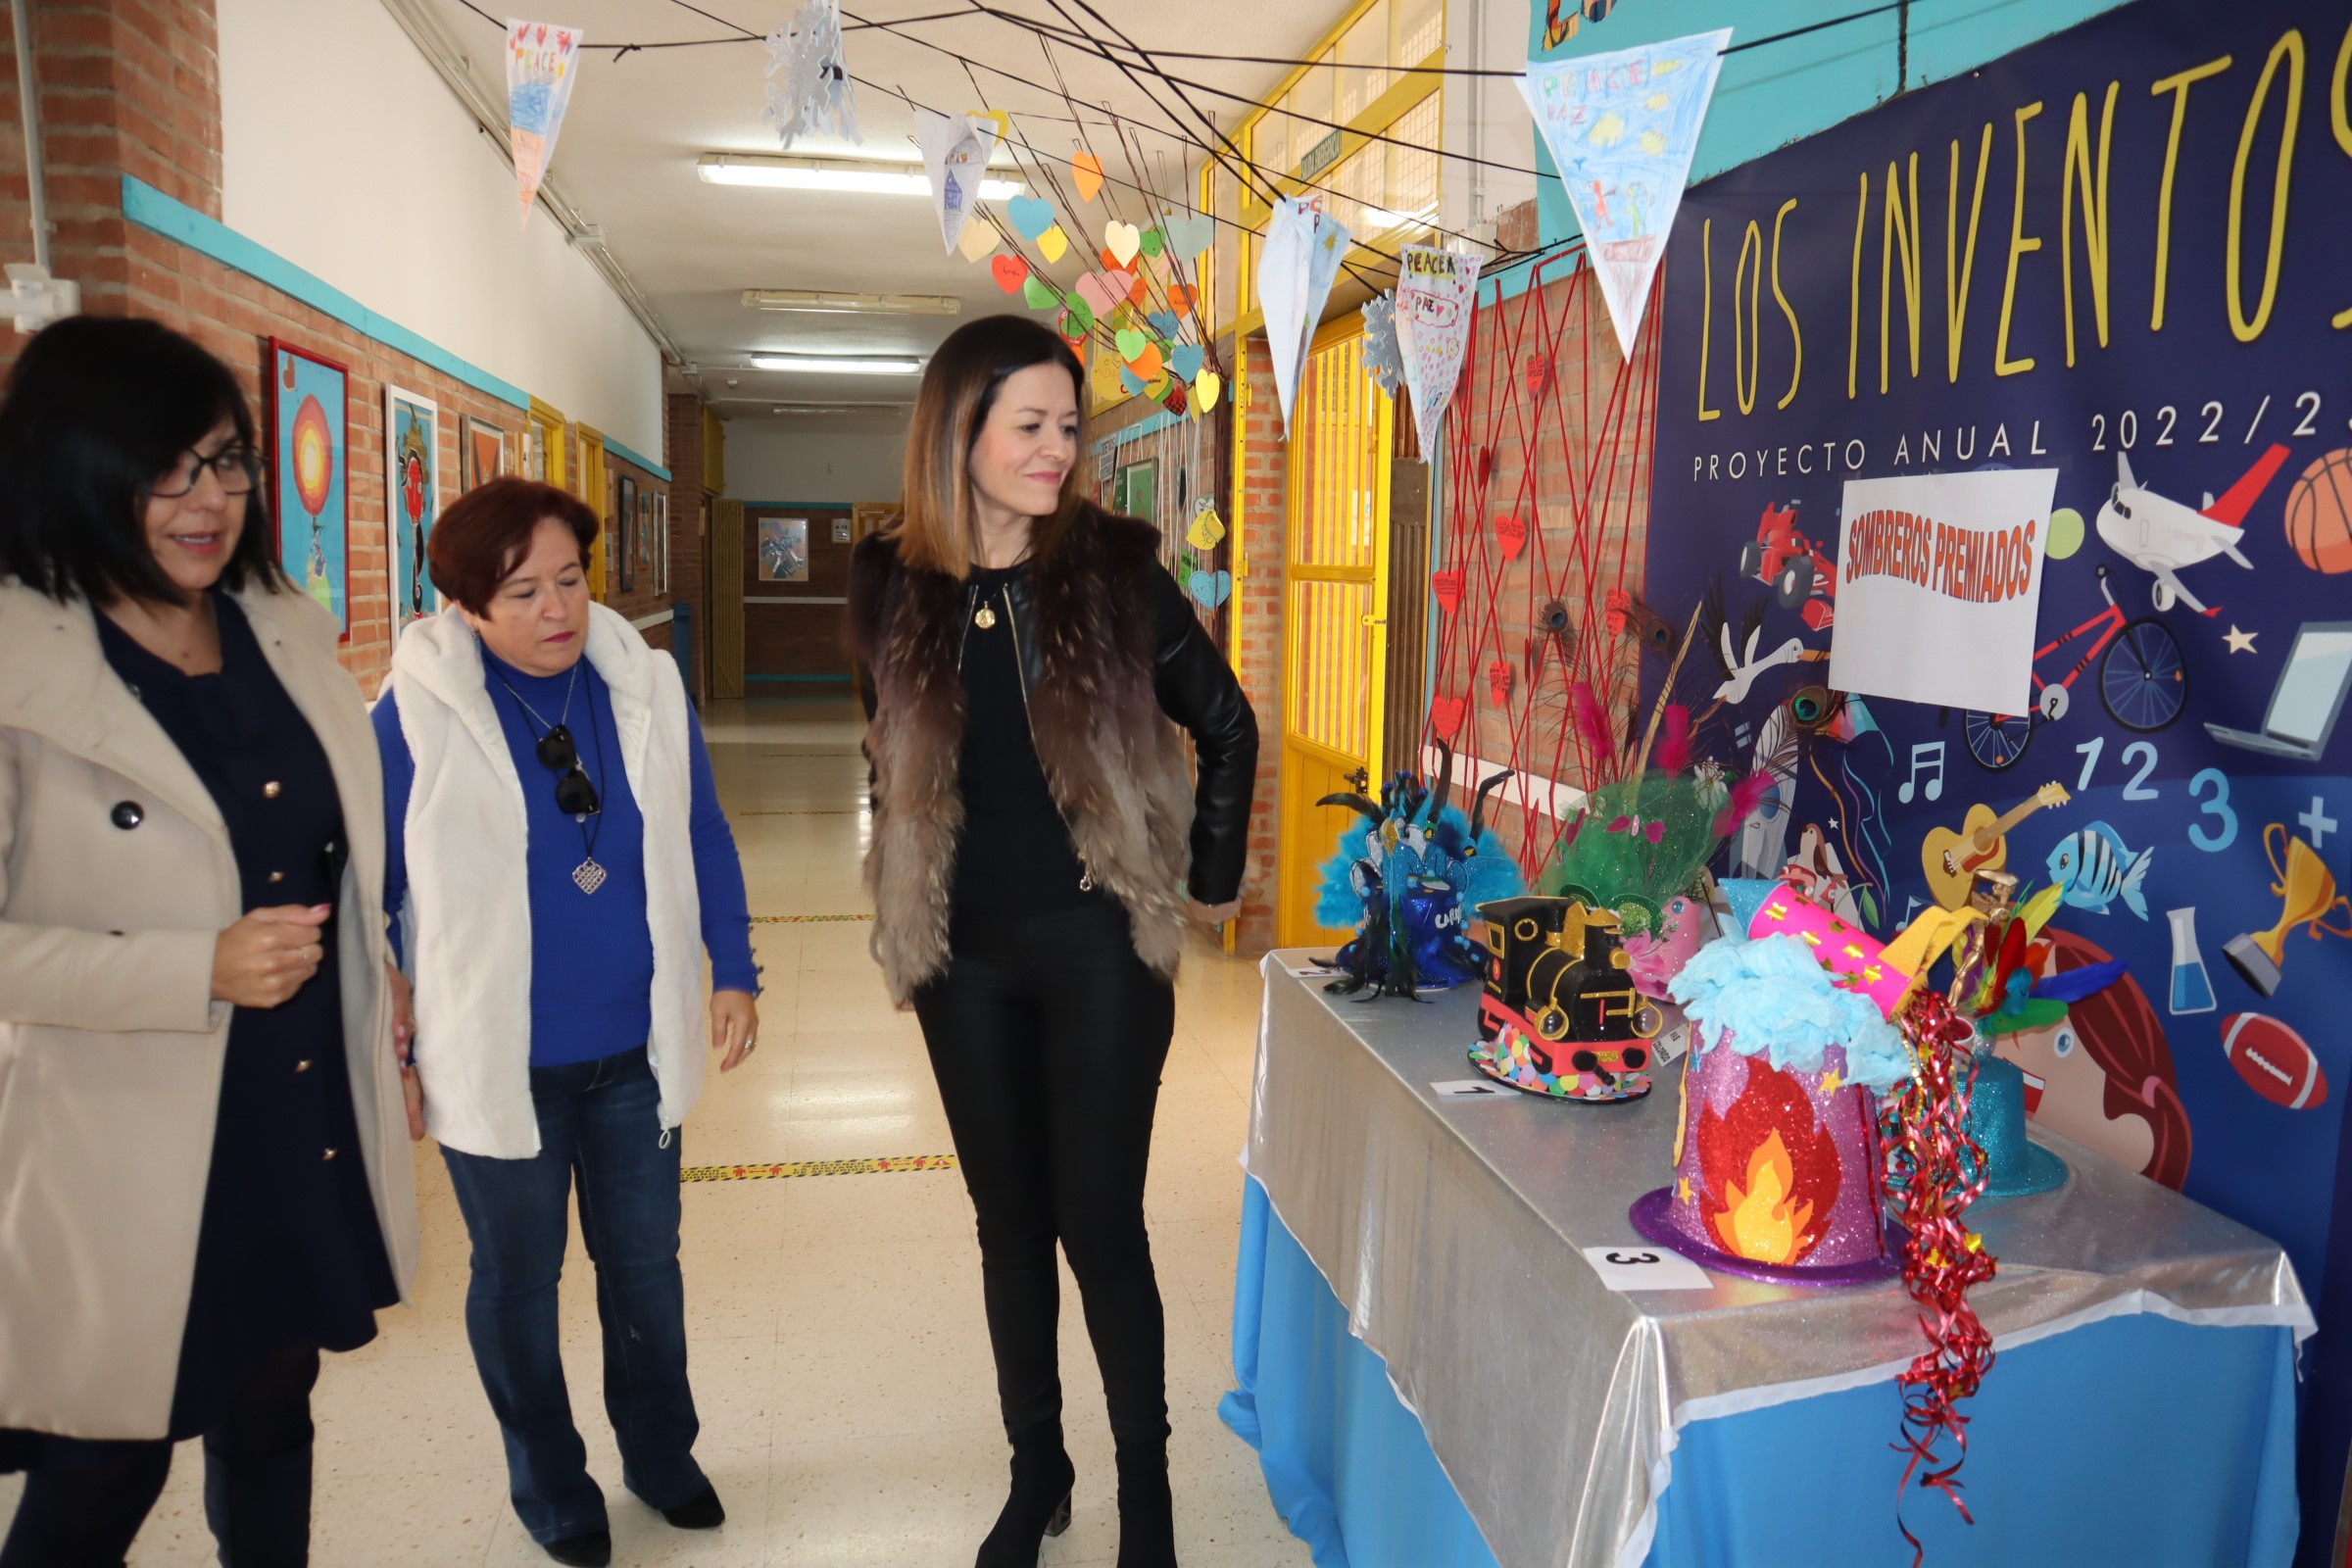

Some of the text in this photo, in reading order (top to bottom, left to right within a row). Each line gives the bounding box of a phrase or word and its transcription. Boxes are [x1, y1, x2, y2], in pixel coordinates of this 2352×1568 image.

[515, 47, 557, 73] PEACE
[1543, 59, 1647, 98] PEACE
[1699, 198, 1801, 421] LOS
[1693, 392, 2352, 481] PROYECTO ANUAL 2022/2
[1846, 510, 2036, 603] SOMBREROS PREMIADOS
[2076, 736, 2238, 852] 1 2 3
[1606, 1252, 1660, 1264] 3
